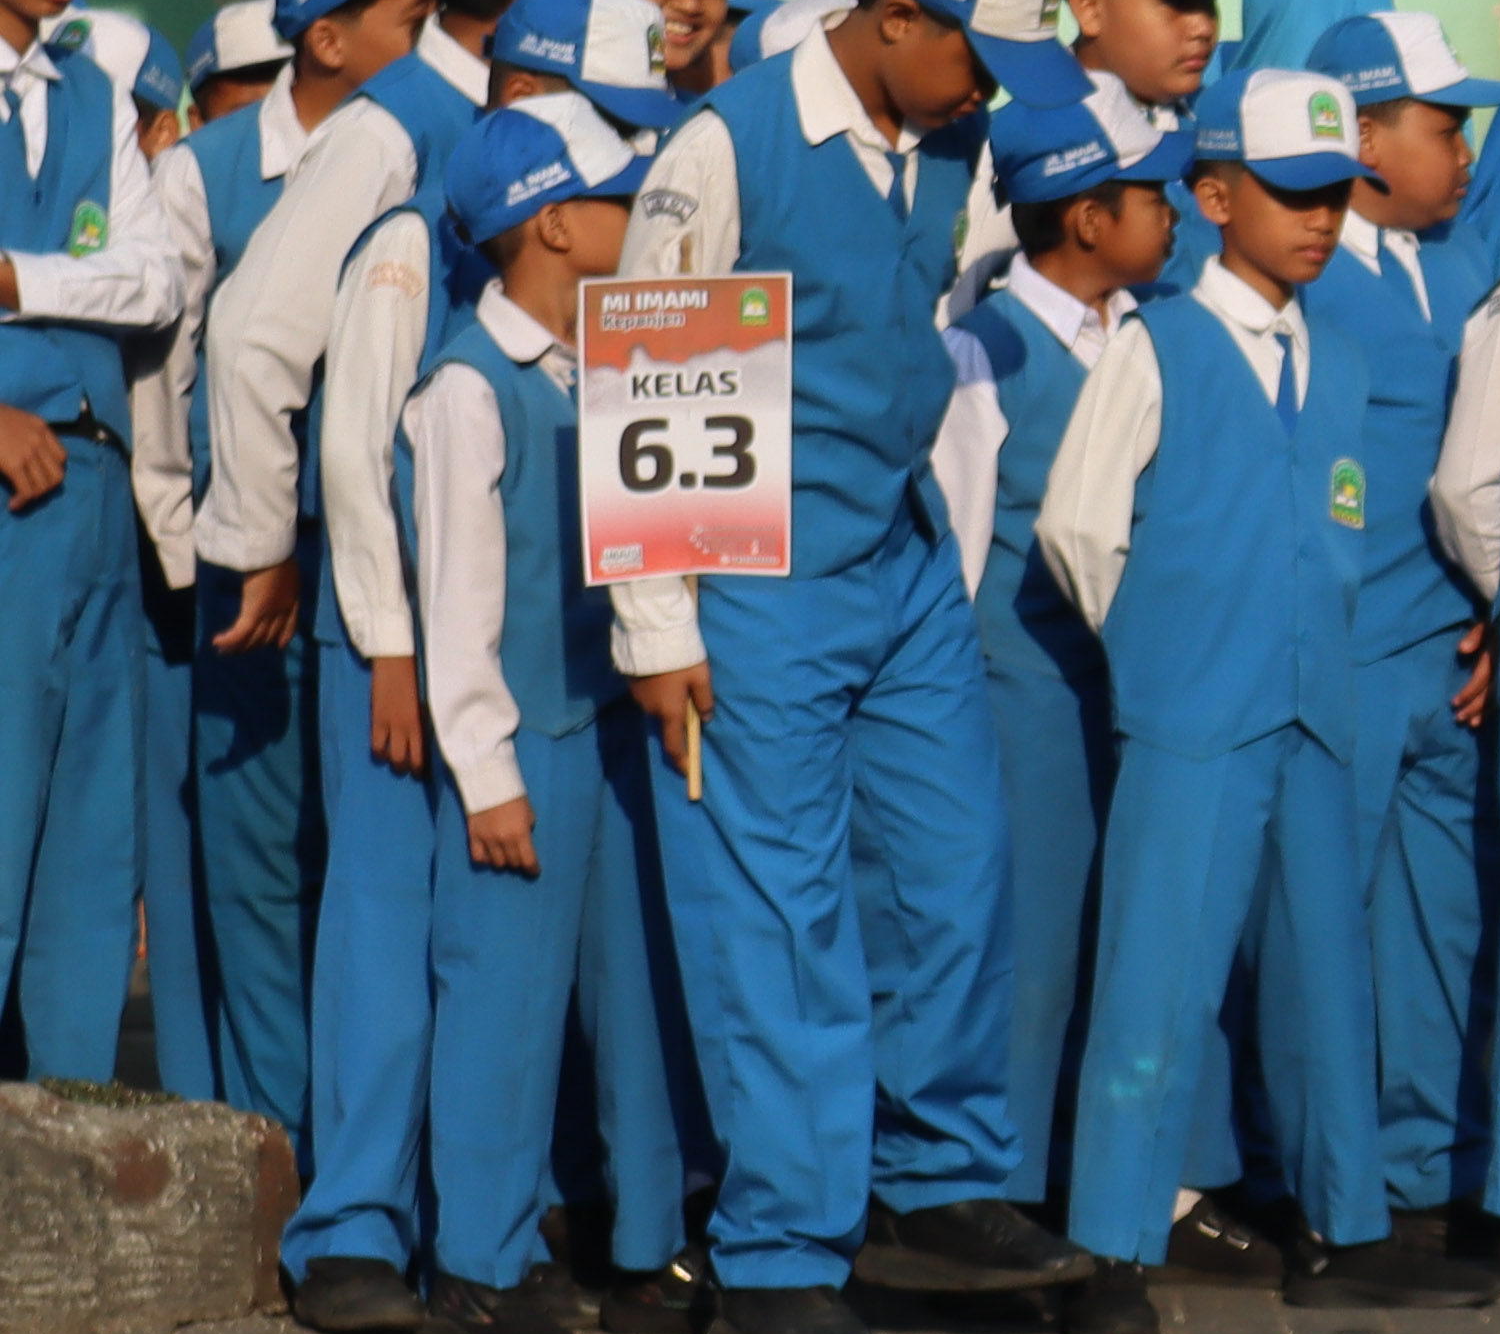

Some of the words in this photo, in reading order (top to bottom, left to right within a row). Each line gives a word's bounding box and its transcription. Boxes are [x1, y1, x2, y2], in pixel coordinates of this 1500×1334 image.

[602, 292, 631, 313] MI
[635, 289, 709, 312] IMAMI
[601, 313, 685, 332] Kepanjen
[631, 369, 739, 399] KELAS
[618, 413, 758, 494] 6.3
